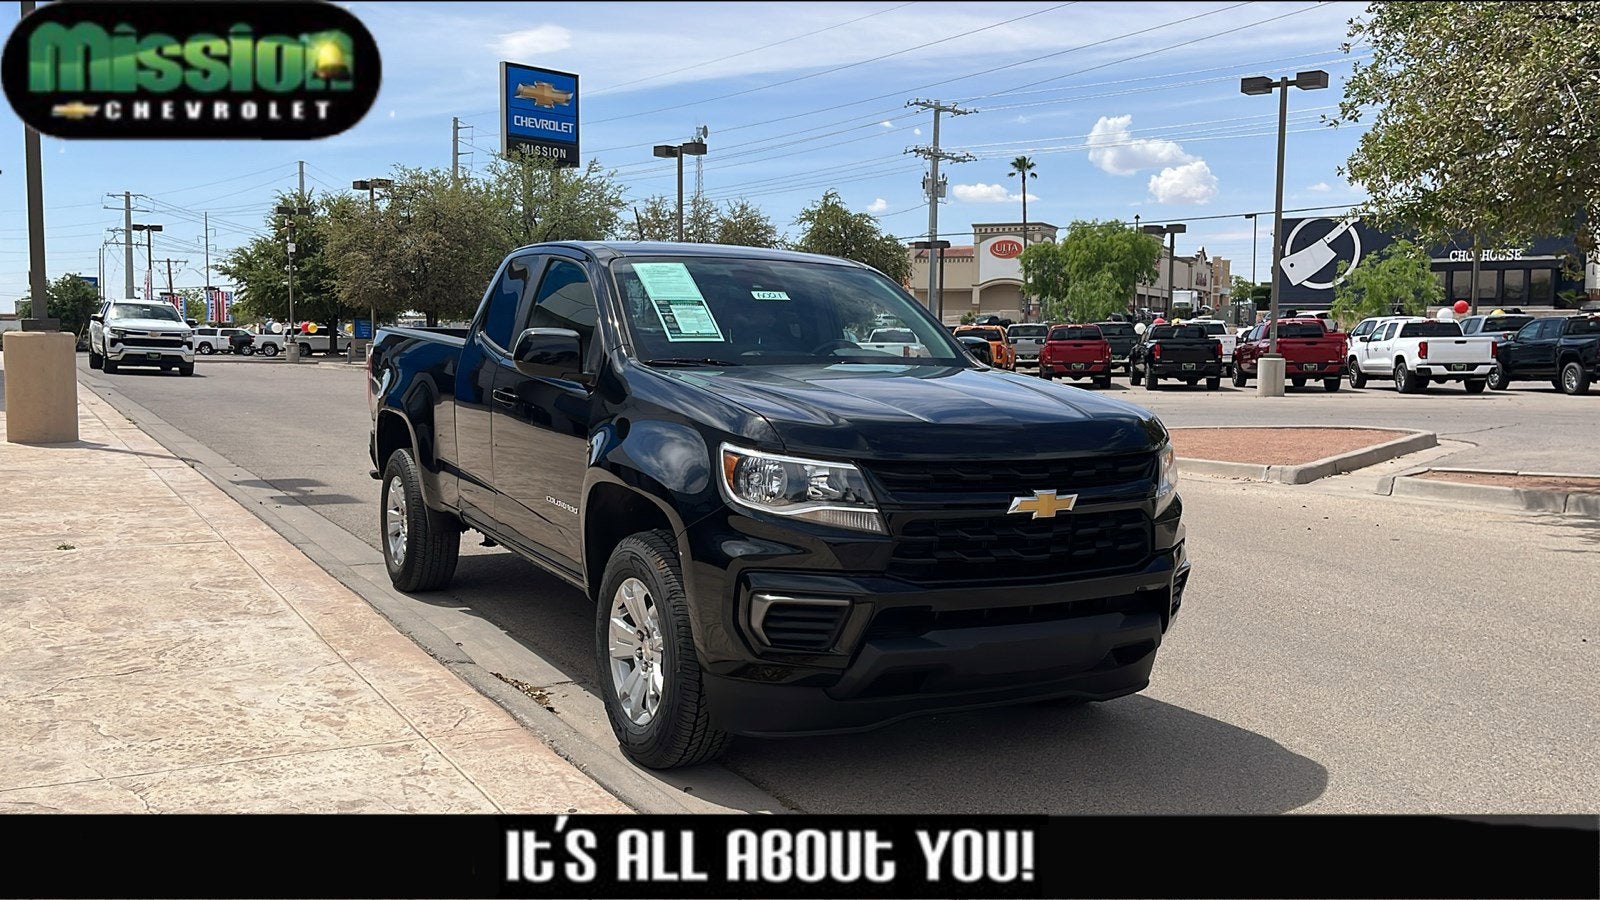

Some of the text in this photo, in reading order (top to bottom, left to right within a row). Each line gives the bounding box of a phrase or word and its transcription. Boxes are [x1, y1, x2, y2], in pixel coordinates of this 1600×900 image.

[514, 115, 574, 133] CHEVROLET
[995, 243, 1018, 251] ULTA
[1449, 248, 1523, 262] CHOHOUSE
